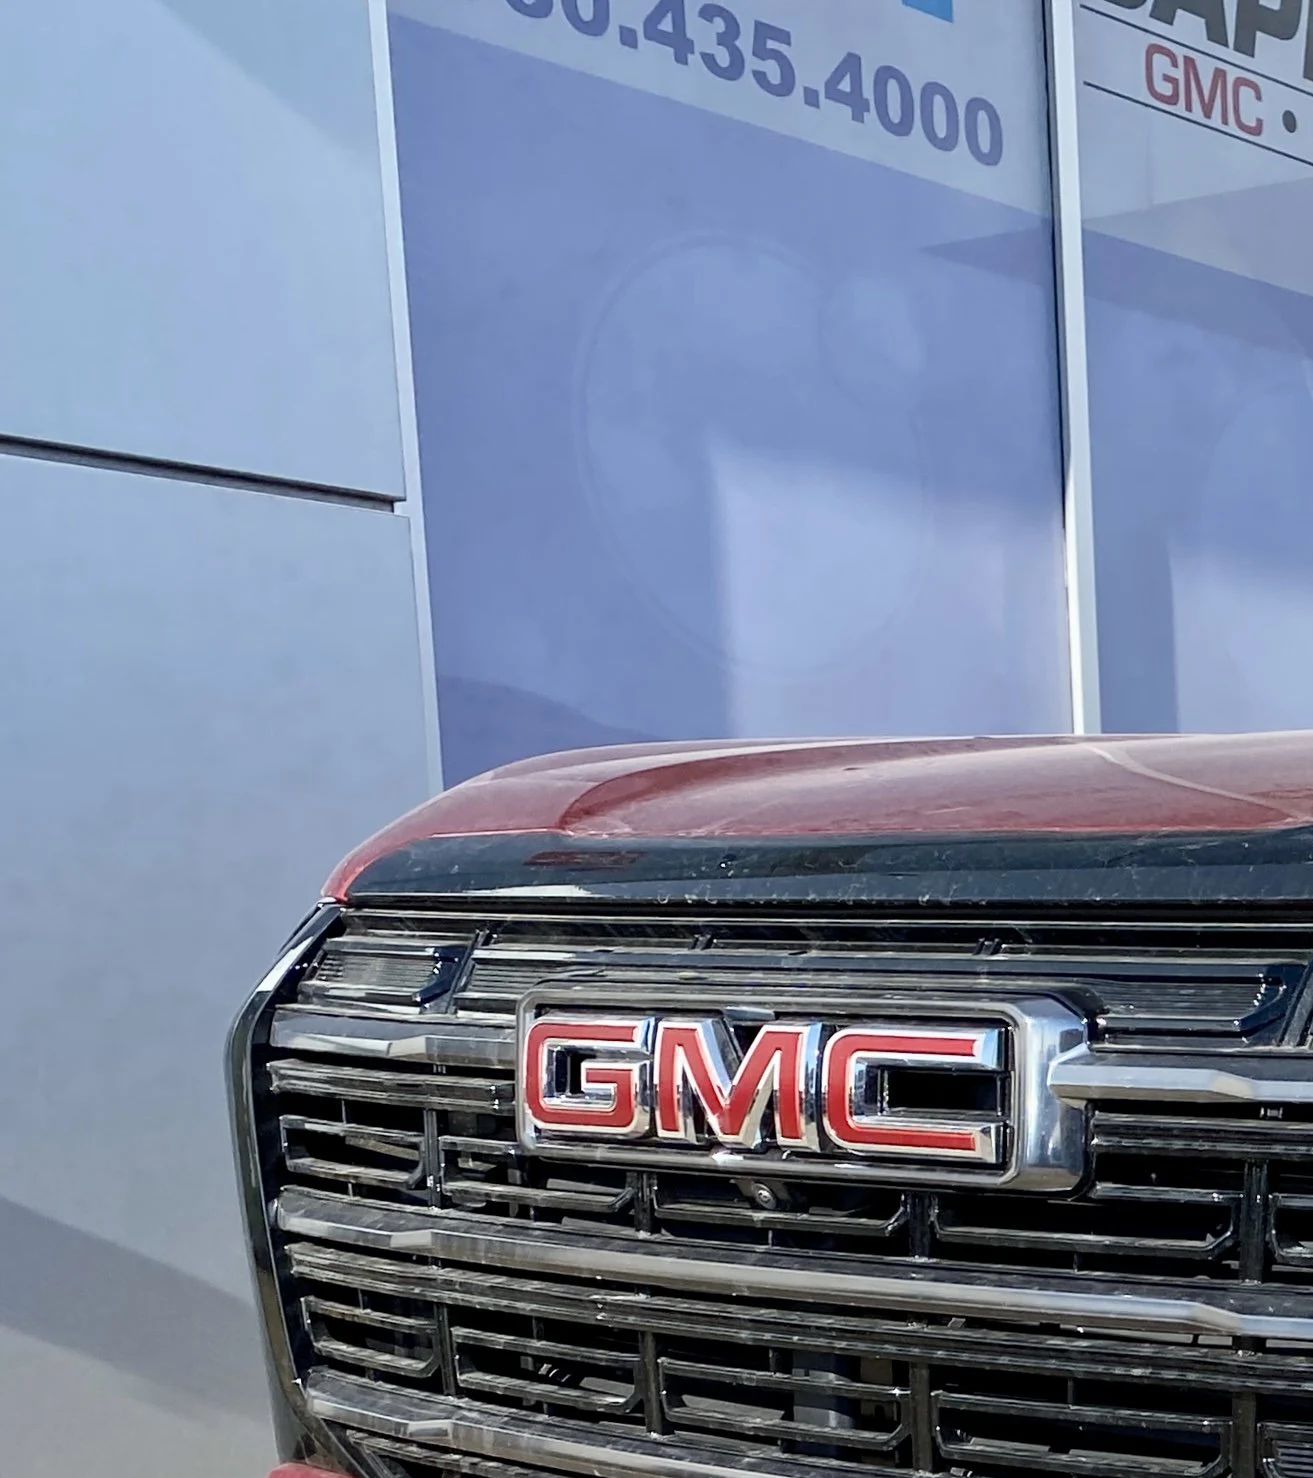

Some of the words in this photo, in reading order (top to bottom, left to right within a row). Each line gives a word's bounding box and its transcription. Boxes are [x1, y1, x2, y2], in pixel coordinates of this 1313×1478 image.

[505, 0, 1005, 166] .435.4000
[1145, 43, 1264, 137] GMC
[525, 1014, 1000, 1163] GMC
